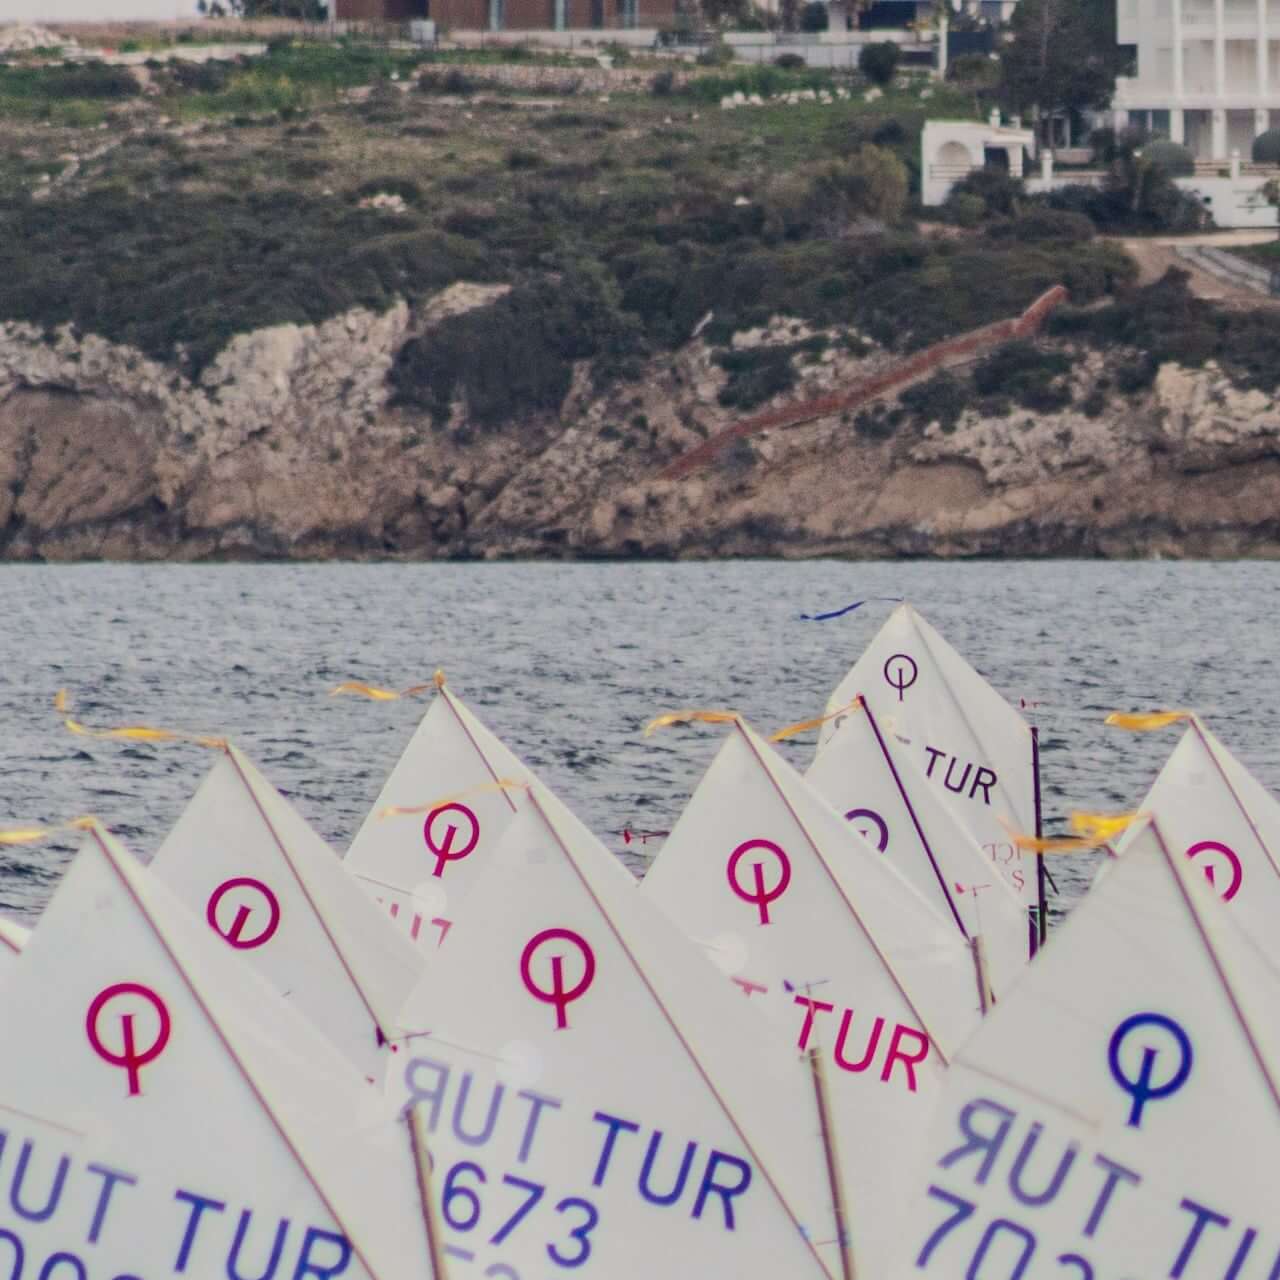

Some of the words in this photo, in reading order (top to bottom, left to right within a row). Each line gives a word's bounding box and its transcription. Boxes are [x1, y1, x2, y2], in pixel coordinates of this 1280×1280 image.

[925, 746, 997, 806] TUR
[794, 994, 930, 1093] TUR
[592, 1111, 753, 1232] TUR
